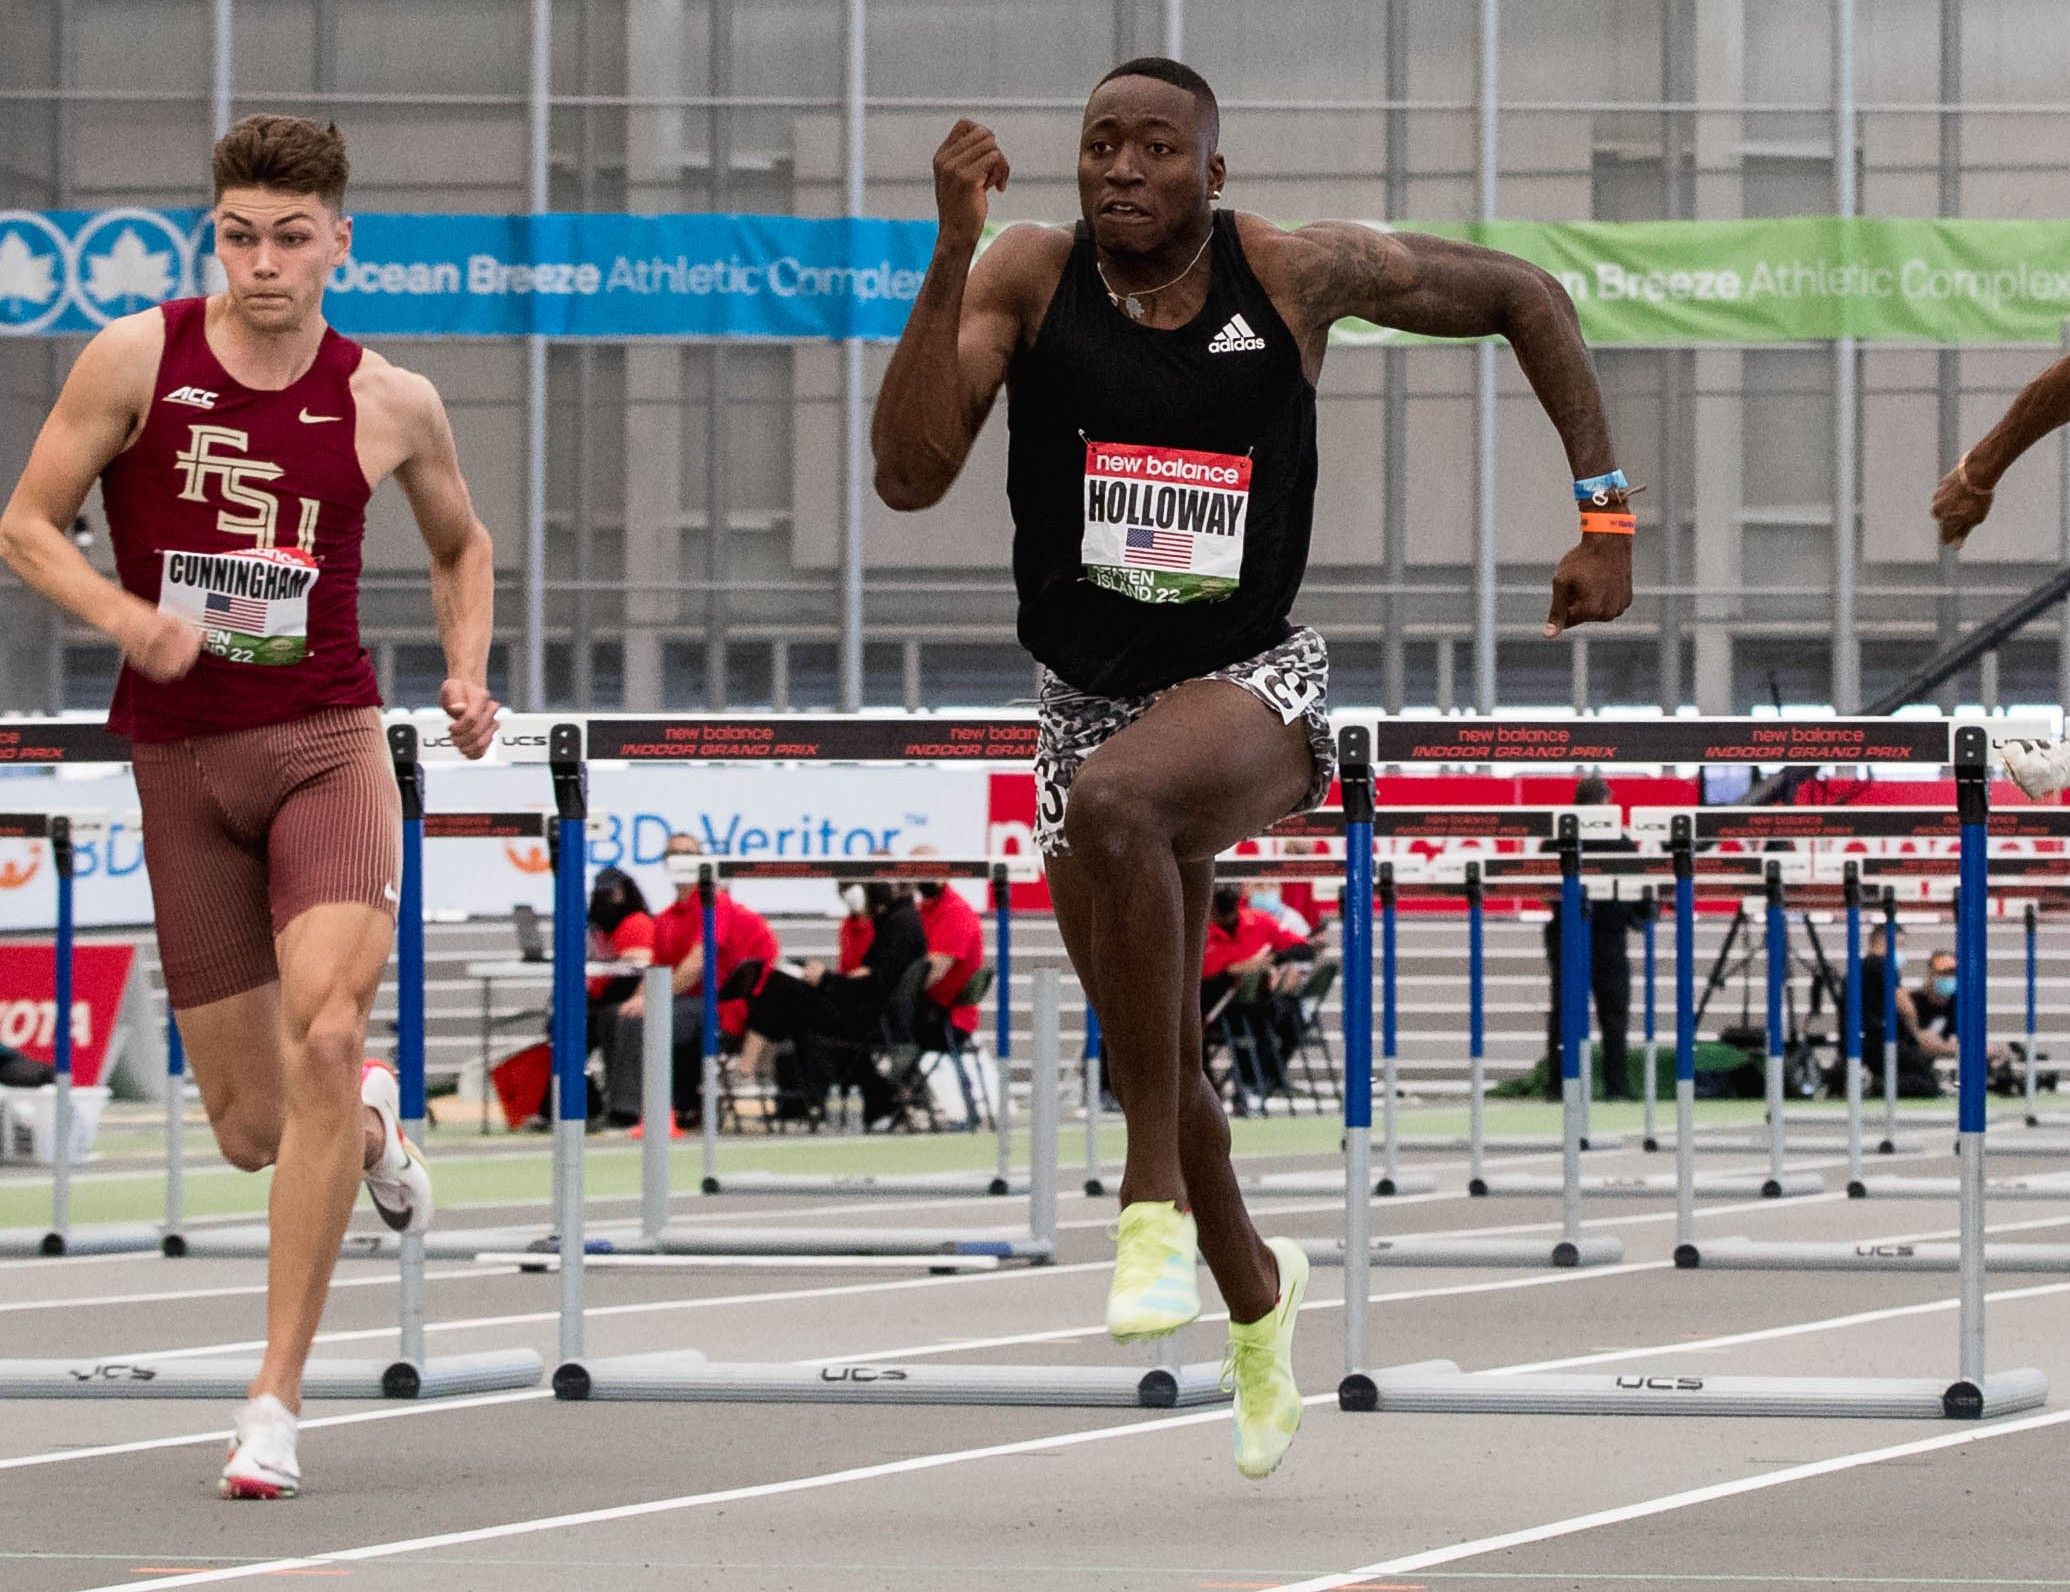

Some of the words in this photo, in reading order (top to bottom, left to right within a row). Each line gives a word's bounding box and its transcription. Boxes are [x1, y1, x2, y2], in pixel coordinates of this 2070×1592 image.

[326, 256, 459, 294] Ocean
[468, 254, 599, 294] Breeze
[607, 253, 760, 295] Athletic
[1596, 262, 1742, 301] Breeze
[1746, 260, 1893, 299] Athletic
[1208, 337, 1266, 354] adidas
[165, 386, 219, 409] ACC
[1096, 454, 1142, 474] new
[1146, 455, 1239, 485] balance
[1088, 480, 1244, 537] HOLLOWAY
[169, 553, 312, 601] CUNNINGHAM
[1155, 587, 1181, 604] 22
[229, 648, 254, 664] 22
[664, 726, 698, 740] new
[703, 725, 774, 741] balance
[950, 727, 985, 740] new
[987, 725, 1041, 741] balan
[1458, 728, 1494, 743] new
[1498, 726, 1571, 743] balance
[1752, 729, 1789, 743] new
[1792, 727, 1866, 743] balance
[423, 736, 455, 748] UC
[502, 736, 547, 747] UCS
[622, 743, 697, 756] INDOOR
[699, 743, 769, 756] GRAND
[773, 743, 818, 756] PRIX
[904, 744, 982, 756] INDOOR
[984, 744, 1038, 756] GRAN
[1412, 745, 1490, 758] INDOOR
[1494, 745, 1566, 758] GRAND
[1569, 745, 1618, 758] PRIX
[1704, 746, 1785, 759] INDOOR
[1787, 746, 1861, 759] GRAND
[1864, 746, 1913, 759] PRIX
[0, 1000, 91, 1048] OTA
[1856, 1245, 1915, 1257] UCS
[820, 1366, 908, 1383] UCS
[1616, 1375, 1704, 1391] UCS
